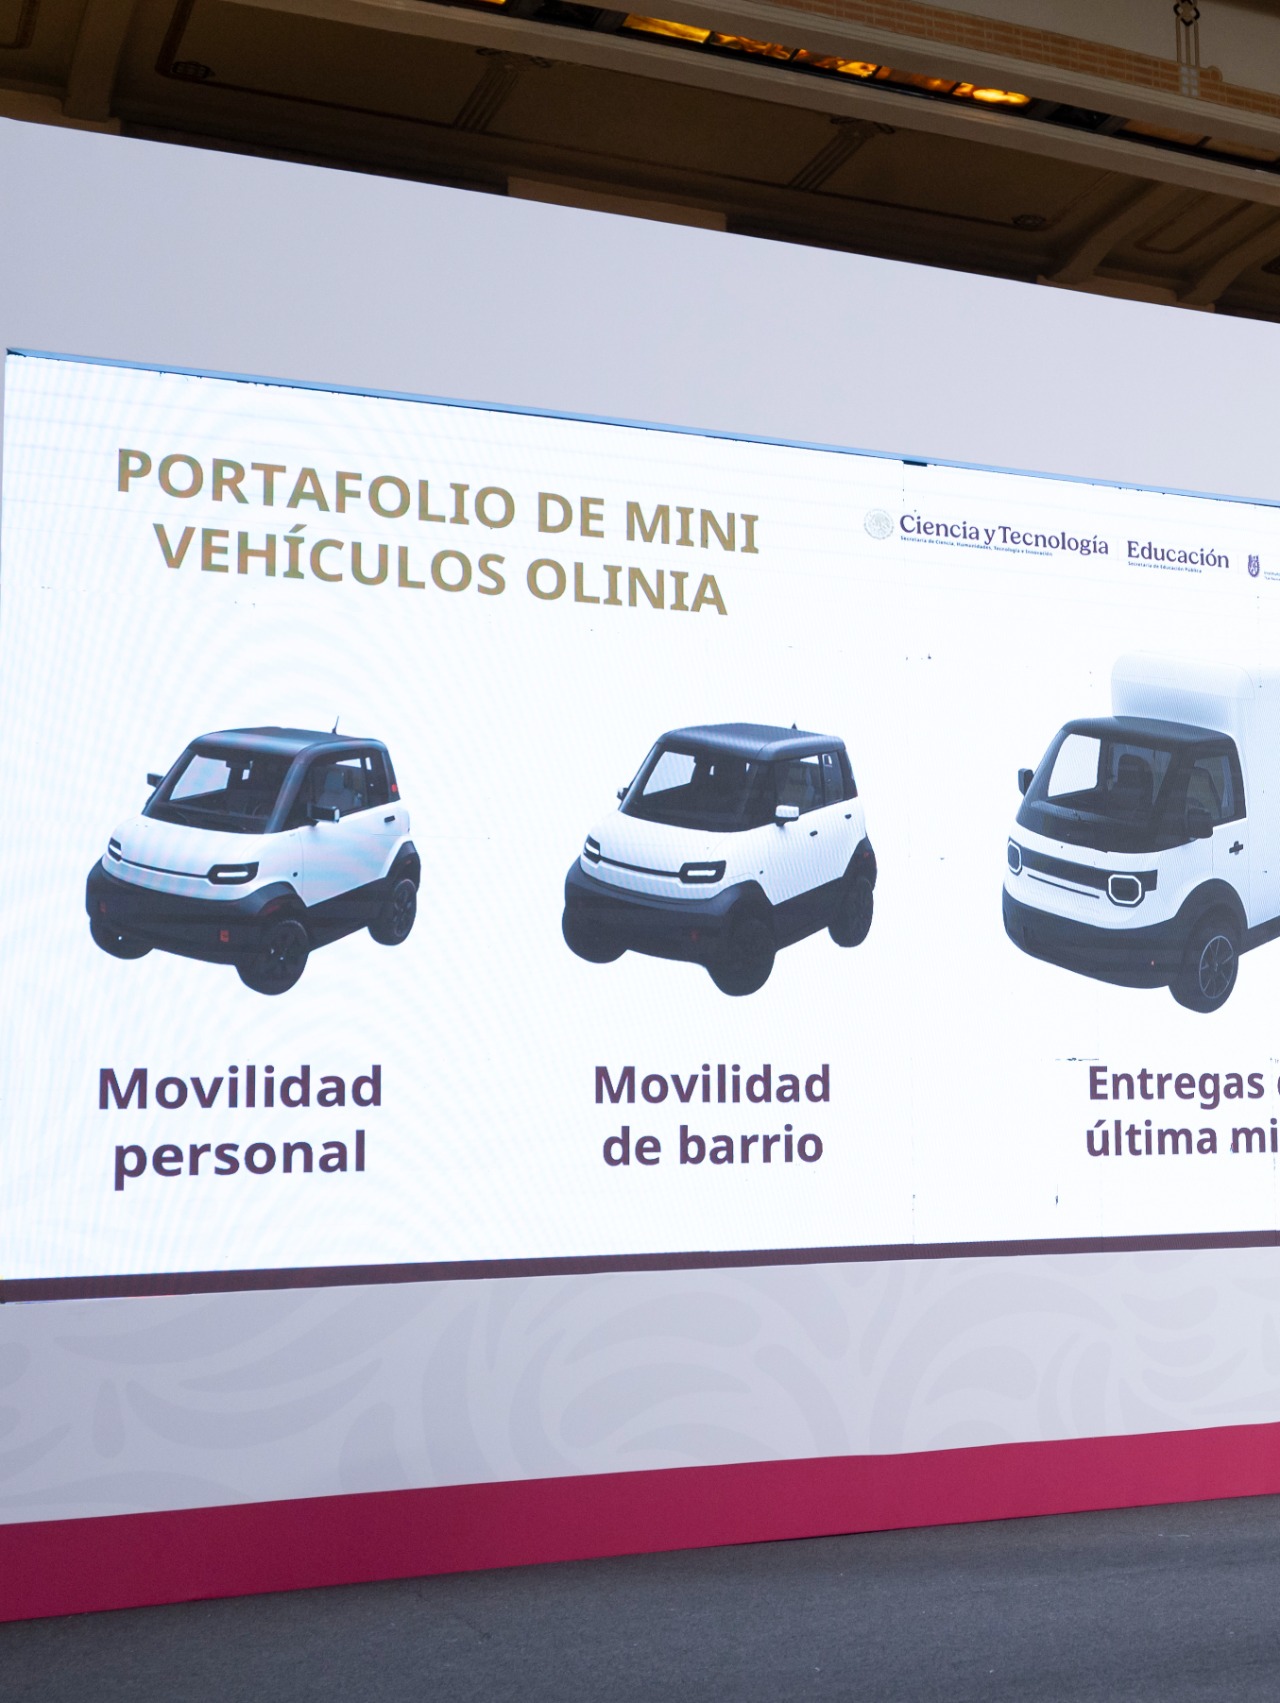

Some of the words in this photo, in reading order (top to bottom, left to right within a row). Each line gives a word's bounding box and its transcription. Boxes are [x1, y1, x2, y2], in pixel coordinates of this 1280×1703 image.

[118, 449, 514, 530] PORTAFOLIO
[539, 493, 604, 537] DE
[627, 502, 758, 553] MINI
[900, 514, 980, 541] Ciencia
[984, 528, 996, 545] y
[998, 525, 1109, 556] Tecnología
[1127, 540, 1230, 569] Educación
[153, 523, 507, 595] VEHÍCULOS
[527, 559, 727, 615] OLINIA
[99, 1065, 381, 1109] Movilidad
[596, 1064, 829, 1103] Movilidad
[1090, 1066, 1264, 1110] Entregas
[603, 1126, 661, 1166] de
[680, 1124, 823, 1164] barrio
[1087, 1120, 1217, 1156] última
[115, 1130, 365, 1191] personal
